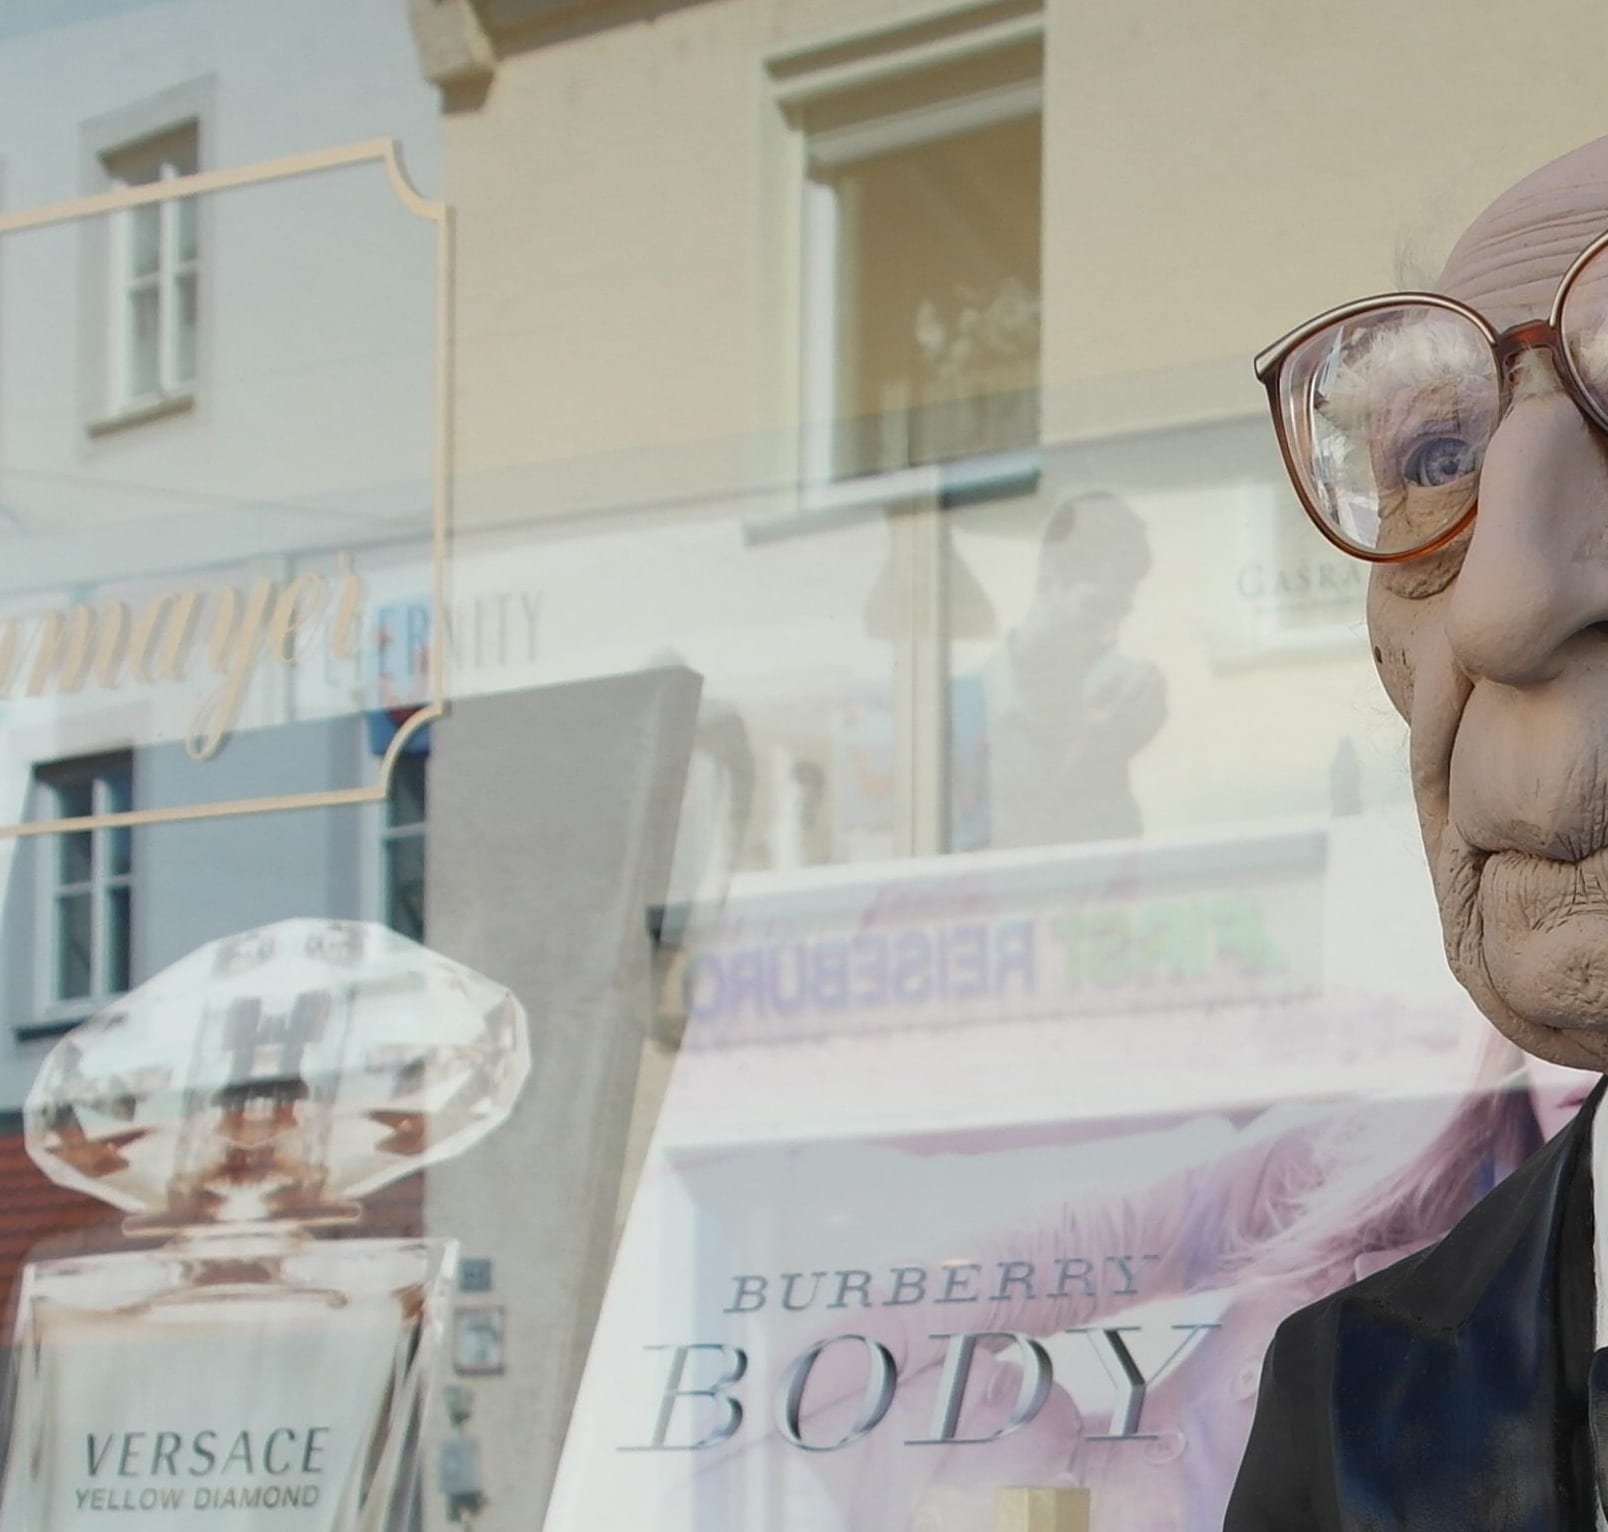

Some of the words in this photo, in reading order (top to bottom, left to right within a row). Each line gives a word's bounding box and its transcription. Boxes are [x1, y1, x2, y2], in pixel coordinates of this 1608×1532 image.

[723, 1254, 1159, 1314] BURBERRY
[616, 1323, 1222, 1453] BODY
[84, 1426, 332, 1478] VERSACE
[75, 1487, 184, 1512] YELLOW
[193, 1484, 321, 1510] DIAMOND
